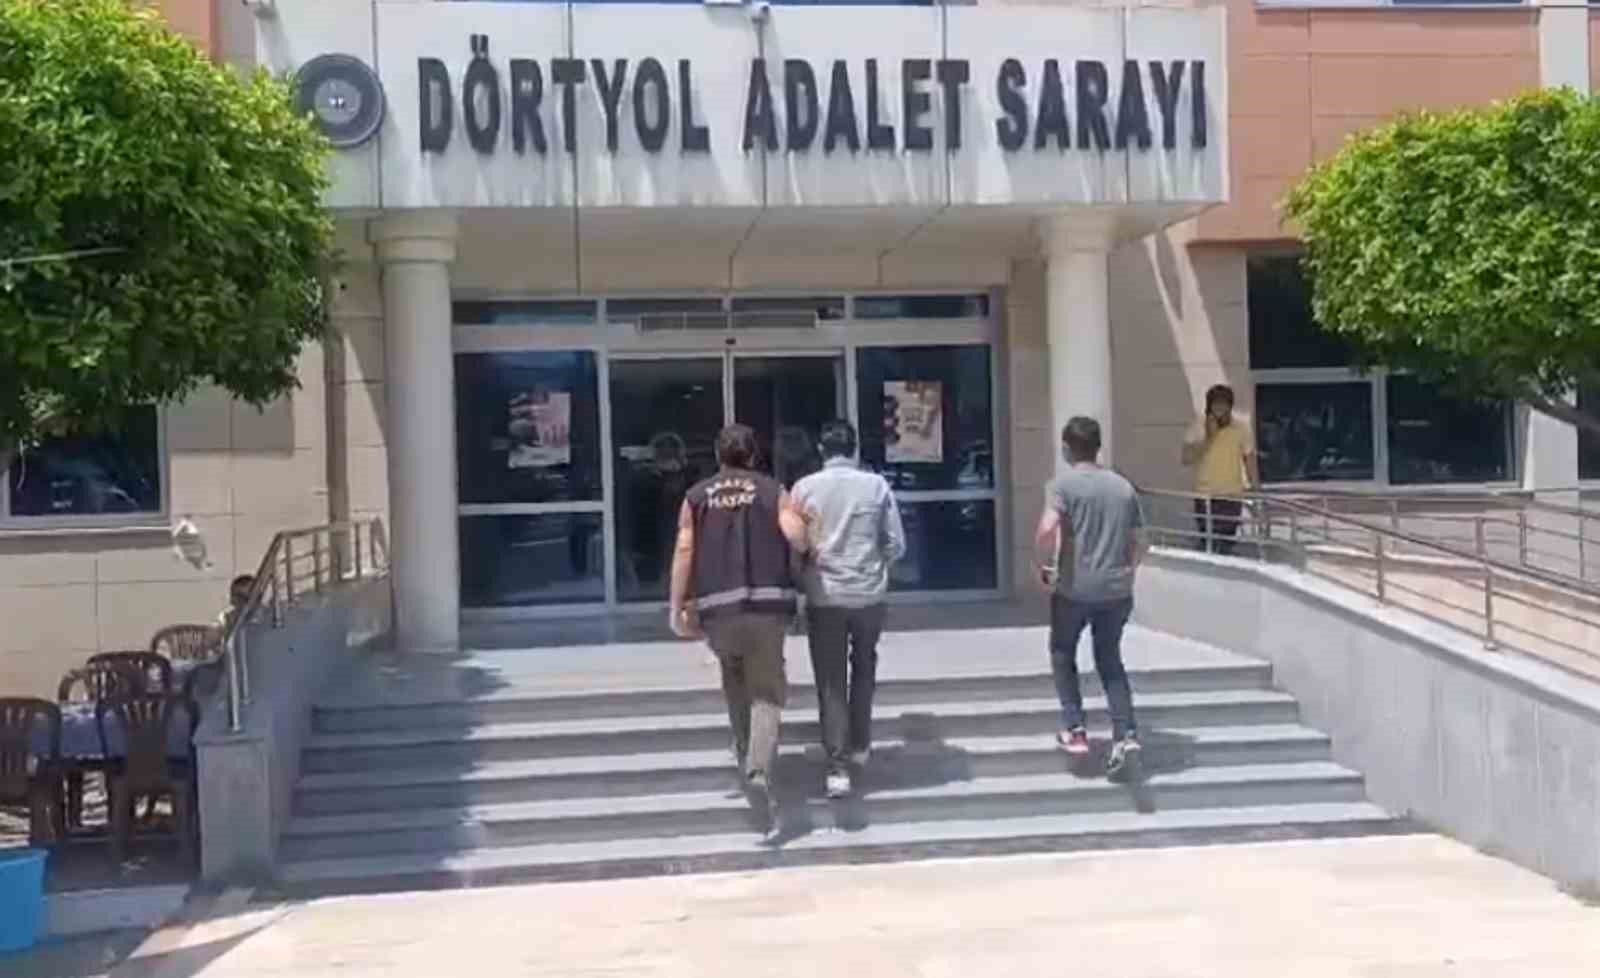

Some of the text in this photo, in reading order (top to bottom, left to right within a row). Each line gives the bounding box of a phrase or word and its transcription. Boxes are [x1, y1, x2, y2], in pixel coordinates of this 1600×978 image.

[418, 34, 1207, 155] DÖRTYOL ADALET SARAYI
